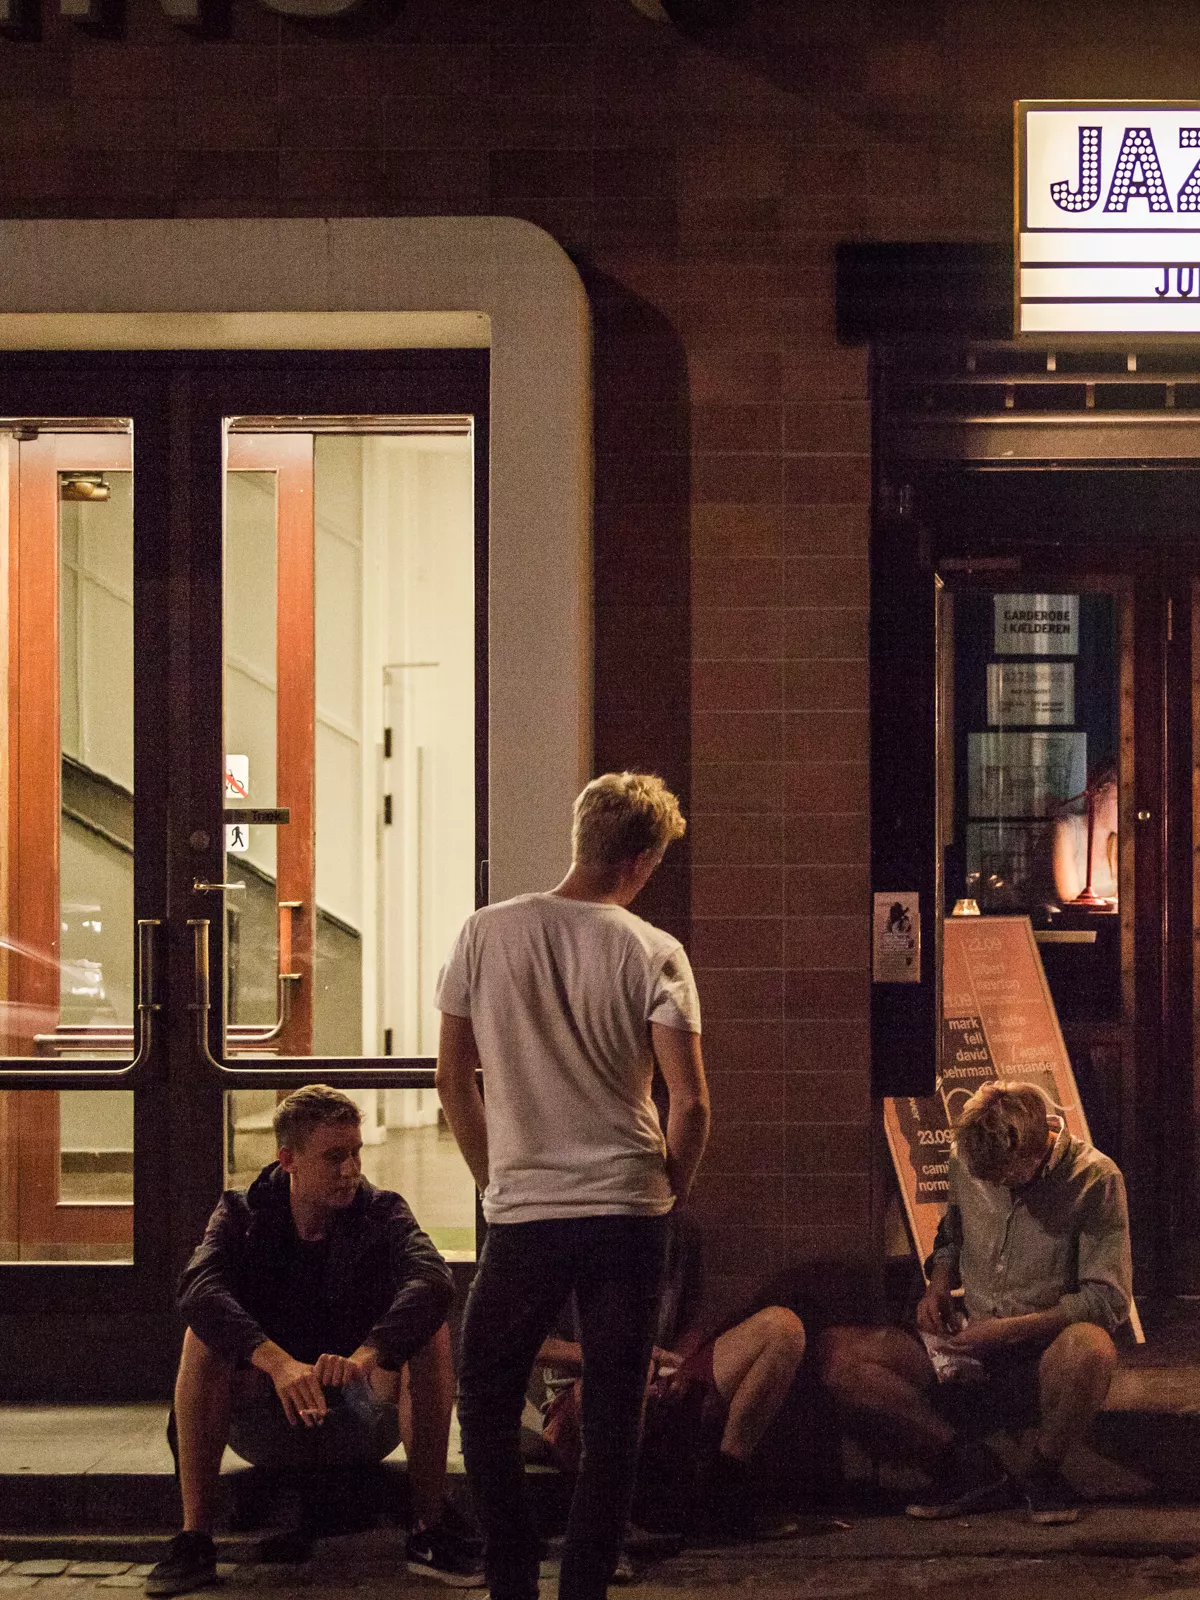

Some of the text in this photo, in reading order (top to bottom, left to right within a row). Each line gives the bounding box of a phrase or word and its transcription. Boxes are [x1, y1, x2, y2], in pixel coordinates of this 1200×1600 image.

[1003, 610, 1071, 621] GARDEROBE
[1010, 623, 1071, 633] KÆLDEREN
[948, 1016, 980, 1030] mark
[963, 1032, 984, 1045] fell
[955, 1047, 988, 1062] david
[917, 1129, 955, 1146] 23.09
[922, 1160, 950, 1175] cami
